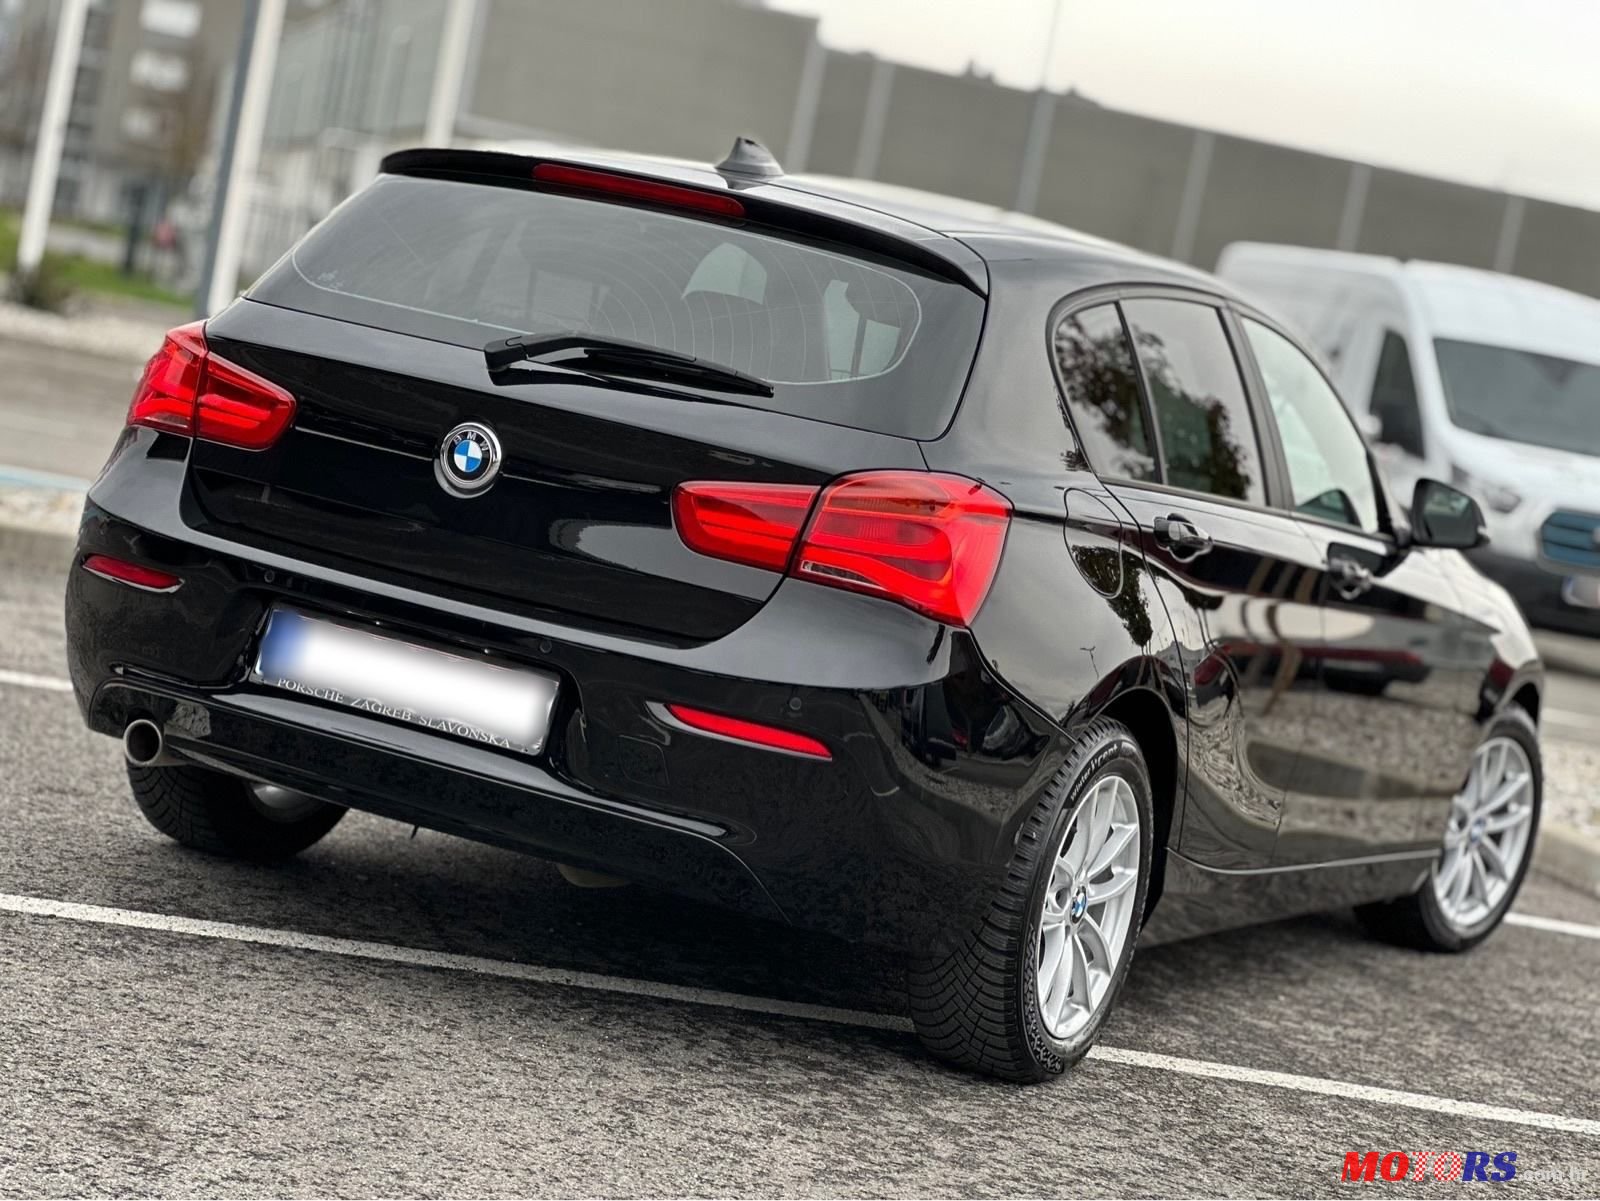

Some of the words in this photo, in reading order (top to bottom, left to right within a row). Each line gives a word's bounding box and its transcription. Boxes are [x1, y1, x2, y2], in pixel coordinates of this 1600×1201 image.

[453, 431, 489, 451] BMW
[277, 678, 344, 703] PORSCHE
[350, 697, 412, 721] ZAGREB
[419, 716, 511, 748] SLAVONSKA
